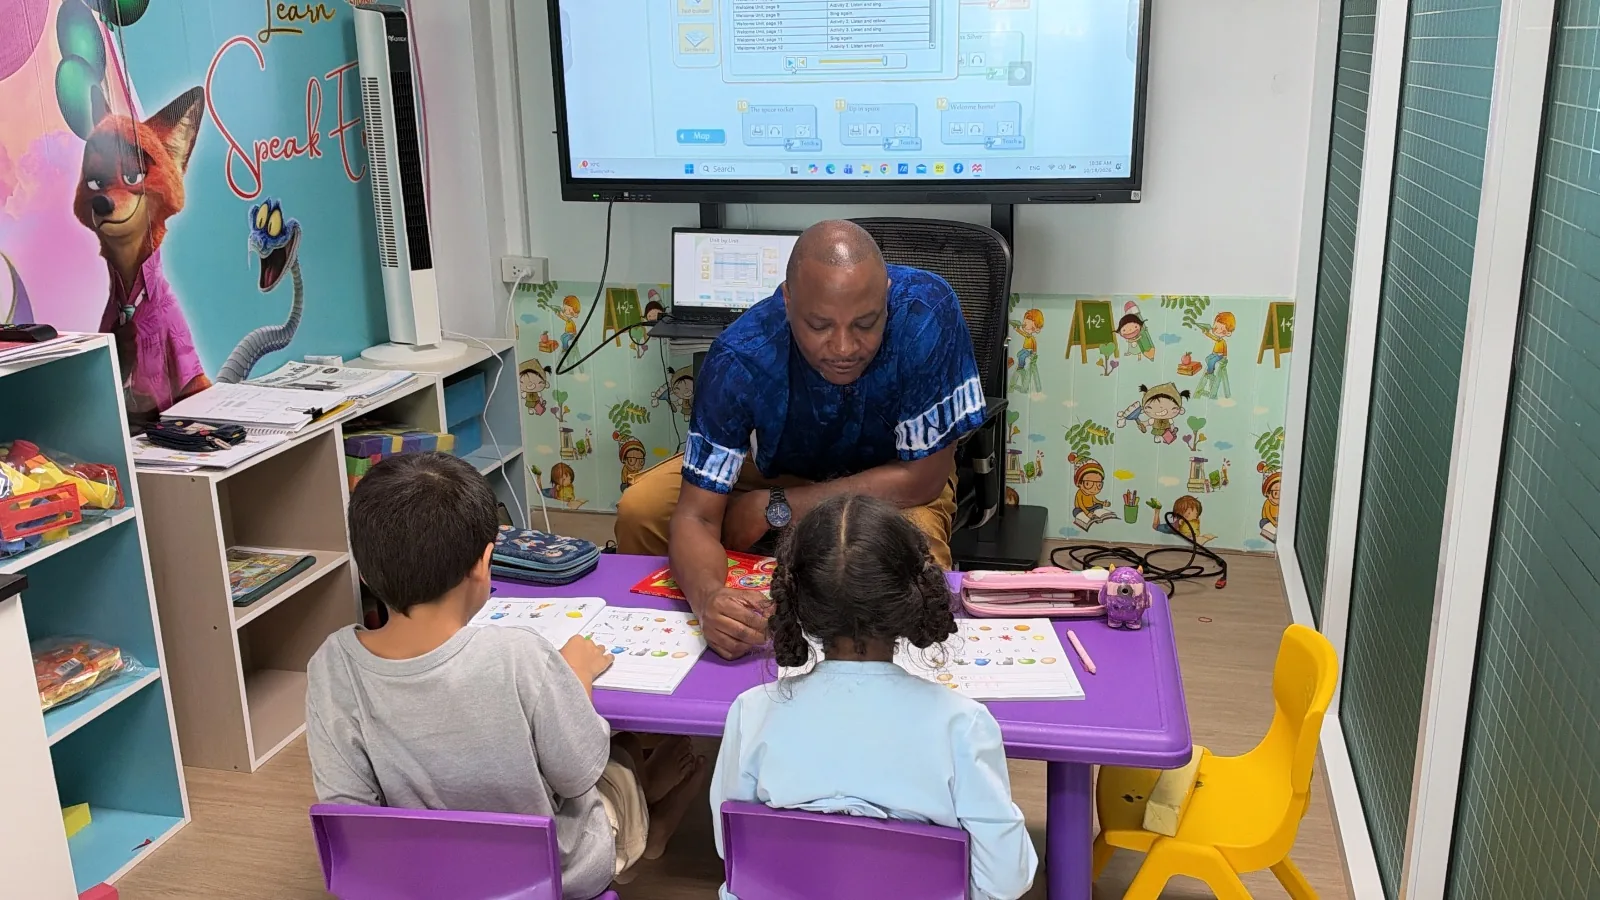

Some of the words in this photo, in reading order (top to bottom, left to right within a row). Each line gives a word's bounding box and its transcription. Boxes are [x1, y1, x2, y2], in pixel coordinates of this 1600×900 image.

[258, 0, 336, 43] Learn
[205, 35, 322, 200] Speak
[693, 132, 710, 141] Map
[1087, 314, 1105, 330] 1+2=
